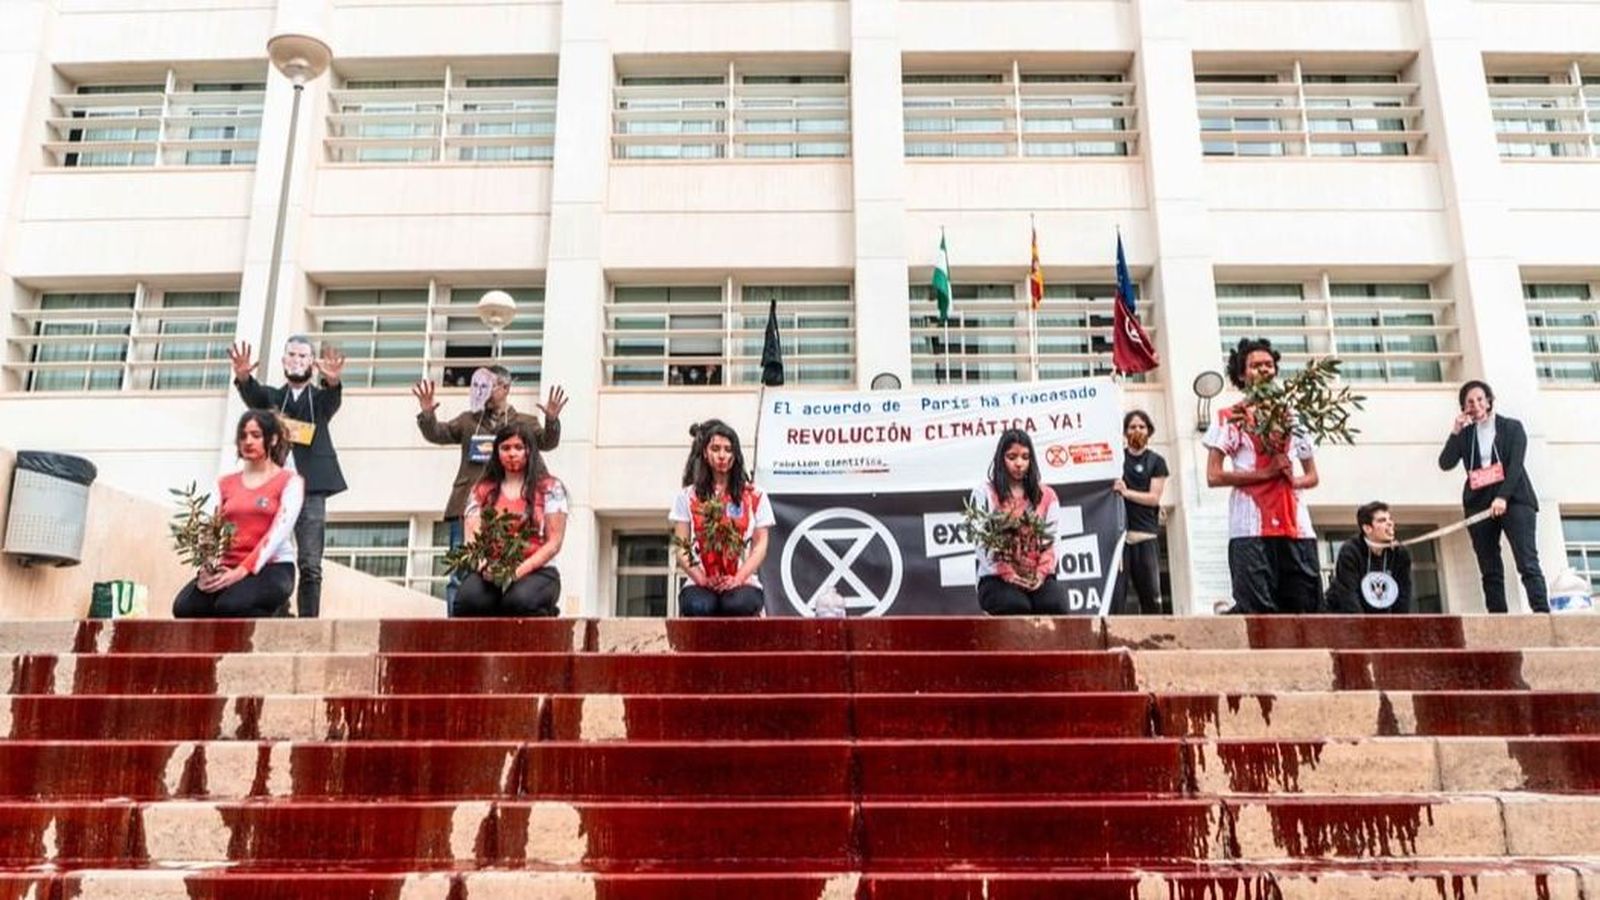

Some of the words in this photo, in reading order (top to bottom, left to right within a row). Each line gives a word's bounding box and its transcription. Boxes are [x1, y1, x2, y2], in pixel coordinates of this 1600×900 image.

[773, 401, 792, 415] El
[802, 400, 872, 415] acuerdo
[882, 399, 901, 413] de
[980, 395, 1000, 408] ha
[1011, 386, 1097, 405] fracasado
[787, 421, 912, 445] REVOLUCIÓN
[925, 416, 1038, 441] CLIMÁTICA
[1049, 412, 1083, 431] YA!
